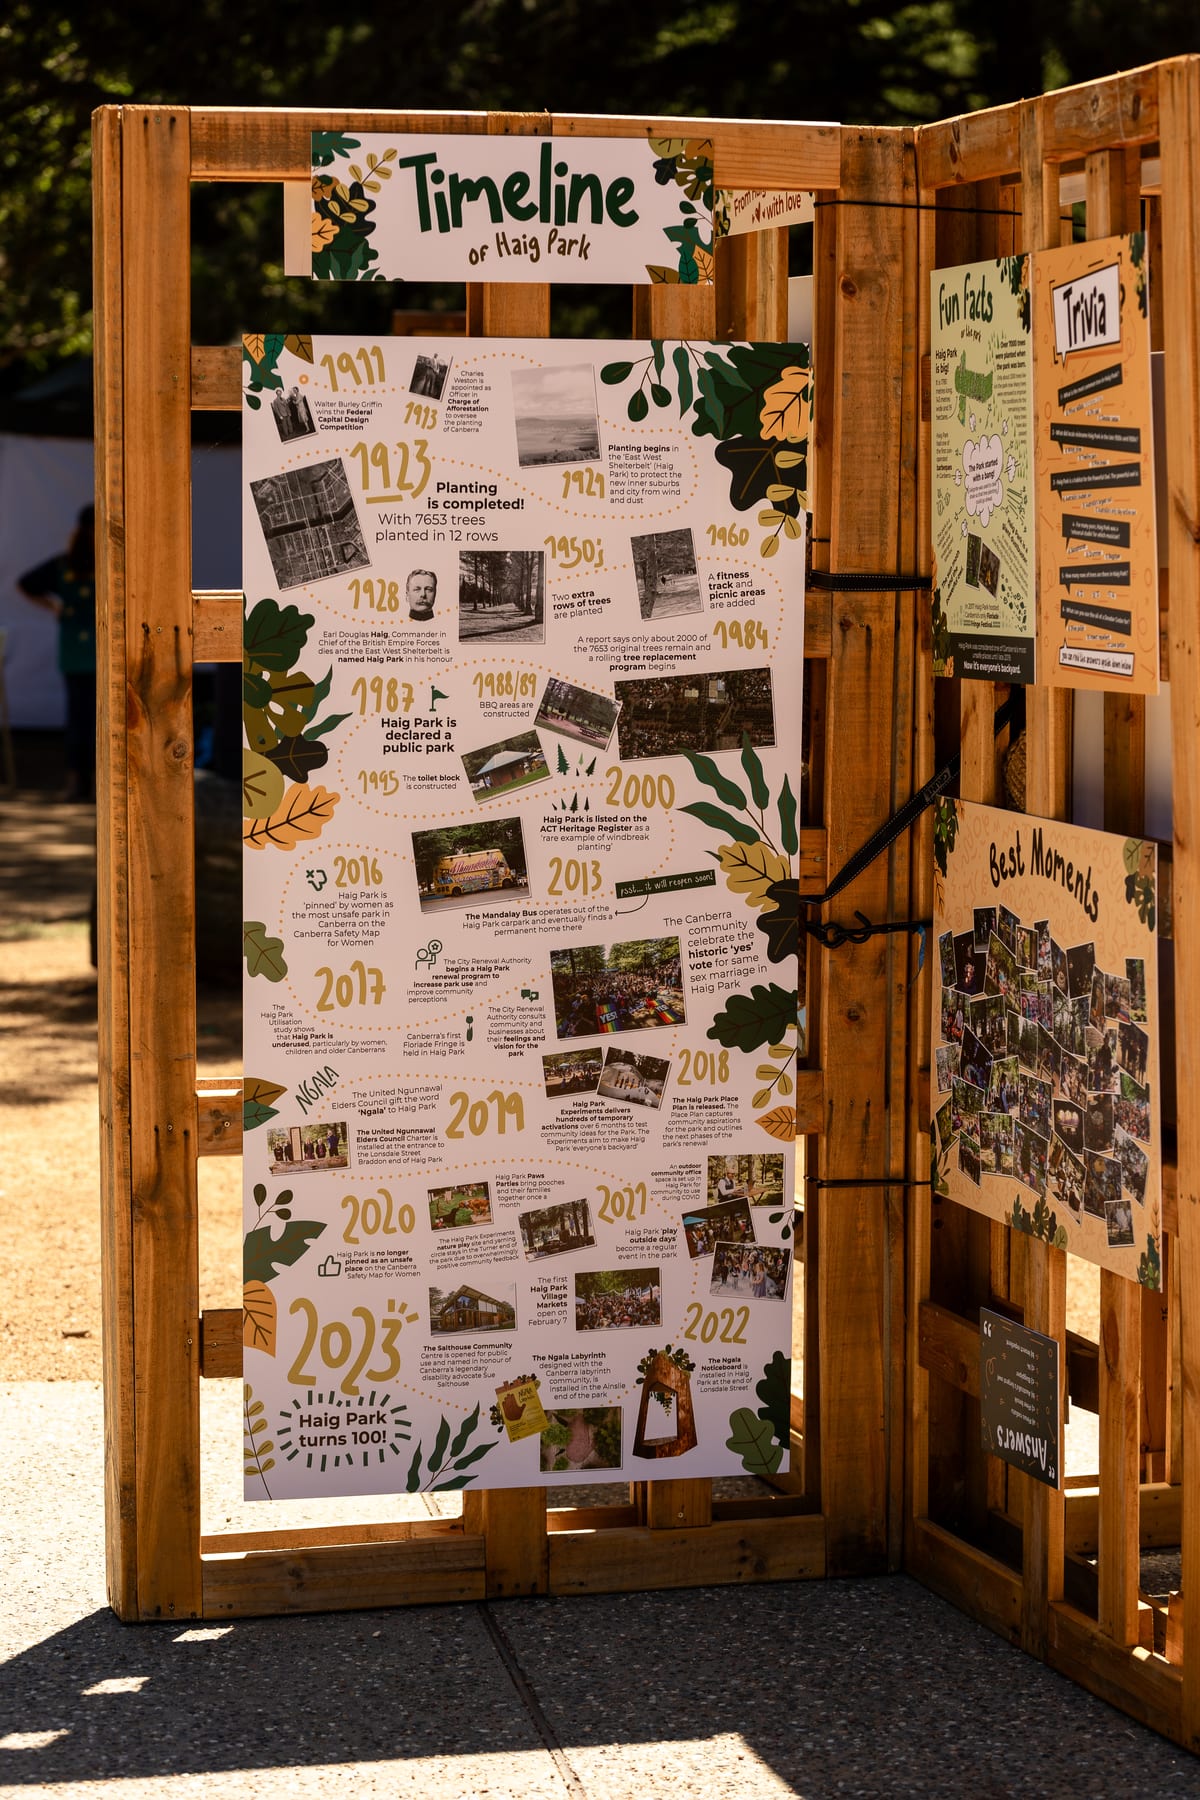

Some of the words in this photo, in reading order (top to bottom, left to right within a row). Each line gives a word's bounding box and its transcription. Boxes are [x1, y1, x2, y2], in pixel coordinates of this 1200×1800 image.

[399, 142, 639, 233] Timeline
[766, 195, 784, 220] with
[785, 192, 801, 212] love
[468, 244, 489, 265] of
[495, 232, 540, 263] Haig
[547, 230, 590, 260] Park
[940, 282, 960, 331] Fun
[964, 272, 993, 323] Facts
[1063, 286, 1107, 347] Trivia
[935, 348, 946, 361] Haig
[946, 347, 957, 358] Park
[320, 345, 385, 392] 1911
[935, 363, 939, 373] is
[939, 362, 949, 375] big!
[338, 400, 360, 409] Burley
[317, 415, 342, 423] Capital
[344, 415, 369, 424] Design
[404, 401, 438, 430] 1913
[319, 423, 363, 431] Competition
[349, 439, 431, 500] 1923
[436, 481, 497, 496] Planting
[562, 467, 605, 499] 1921
[427, 497, 438, 509] is
[442, 497, 524, 512] completed!
[378, 512, 411, 525] With
[415, 513, 447, 525] 7653
[450, 514, 485, 525] trees
[375, 529, 428, 543] planted
[433, 529, 445, 541] in
[448, 529, 462, 541] 12
[466, 532, 498, 541] rows
[706, 522, 749, 547] 1960
[708, 573, 714, 581] A
[716, 571, 749, 580] fitness
[708, 580, 733, 590] track
[735, 579, 752, 588] and
[348, 578, 399, 612] 1928
[709, 590, 737, 600] picnic
[740, 588, 765, 597] areas
[709, 601, 724, 609] are
[726, 598, 755, 607] added
[713, 619, 769, 650] 1984
[472, 670, 537, 701] 1988/89
[351, 675, 414, 715] 1987
[480, 702, 497, 710] BBQ
[381, 716, 410, 730] Haig
[414, 717, 443, 727] Park
[446, 719, 456, 727] is
[385, 729, 440, 740] declared
[444, 731, 451, 740] a
[383, 742, 422, 755] public
[426, 742, 454, 754] park
[358, 770, 399, 796] 1995
[605, 766, 675, 809] 2000
[543, 815, 562, 824] Haig
[595, 814, 618, 822] listed
[632, 814, 647, 822] the
[559, 824, 595, 833] Heritage
[597, 823, 632, 833] Register
[334, 855, 383, 887] 2016
[548, 857, 602, 896] 2013
[989, 841, 1025, 888] Best
[1030, 827, 1099, 923] Moments
[644, 881, 652, 890] it
[653, 878, 667, 889] will
[694, 871, 716, 883] soon!
[662, 917, 682, 926] The
[684, 911, 732, 923] Canberra
[688, 920, 748, 935] community
[687, 934, 735, 947] celebrate
[737, 931, 754, 940] the
[688, 945, 728, 959] historic
[688, 960, 712, 970] vote
[714, 958, 728, 966] for
[731, 954, 758, 965] same
[689, 973, 706, 982] sex
[709, 967, 755, 979] marriage
[757, 965, 767, 973] in
[314, 960, 386, 1012] 2017
[690, 984, 714, 994] Haig
[717, 980, 740, 990] Park
[677, 1049, 729, 1085] 2018
[295, 1065, 339, 1115] NGALA
[369, 1087, 395, 1097] United
[397, 1083, 442, 1095] Ngunnawal
[331, 1101, 356, 1109] Elders
[357, 1097, 387, 1107] Council
[388, 1096, 403, 1106] gift
[403, 1095, 418, 1103] the
[418, 1093, 439, 1101] word
[398, 1104, 416, 1112] Haig
[418, 1102, 436, 1110] Park
[445, 1090, 525, 1139] 2019
[596, 1181, 646, 1224] 2021
[341, 1188, 415, 1245] 2020
[530, 1284, 548, 1293] Haig
[549, 1283, 567, 1291] Park
[541, 1292, 567, 1300] Village
[528, 1318, 561, 1326] February
[536, 1310, 556, 1318] open
[684, 1303, 750, 1344] 2022
[287, 1297, 402, 1396] 2023
[299, 1412, 339, 1429] Haig
[346, 1410, 387, 1425] Park
[298, 1434, 346, 1447] turns
[351, 1430, 386, 1444] 100!
[997, 1425, 1047, 1471] Answers
